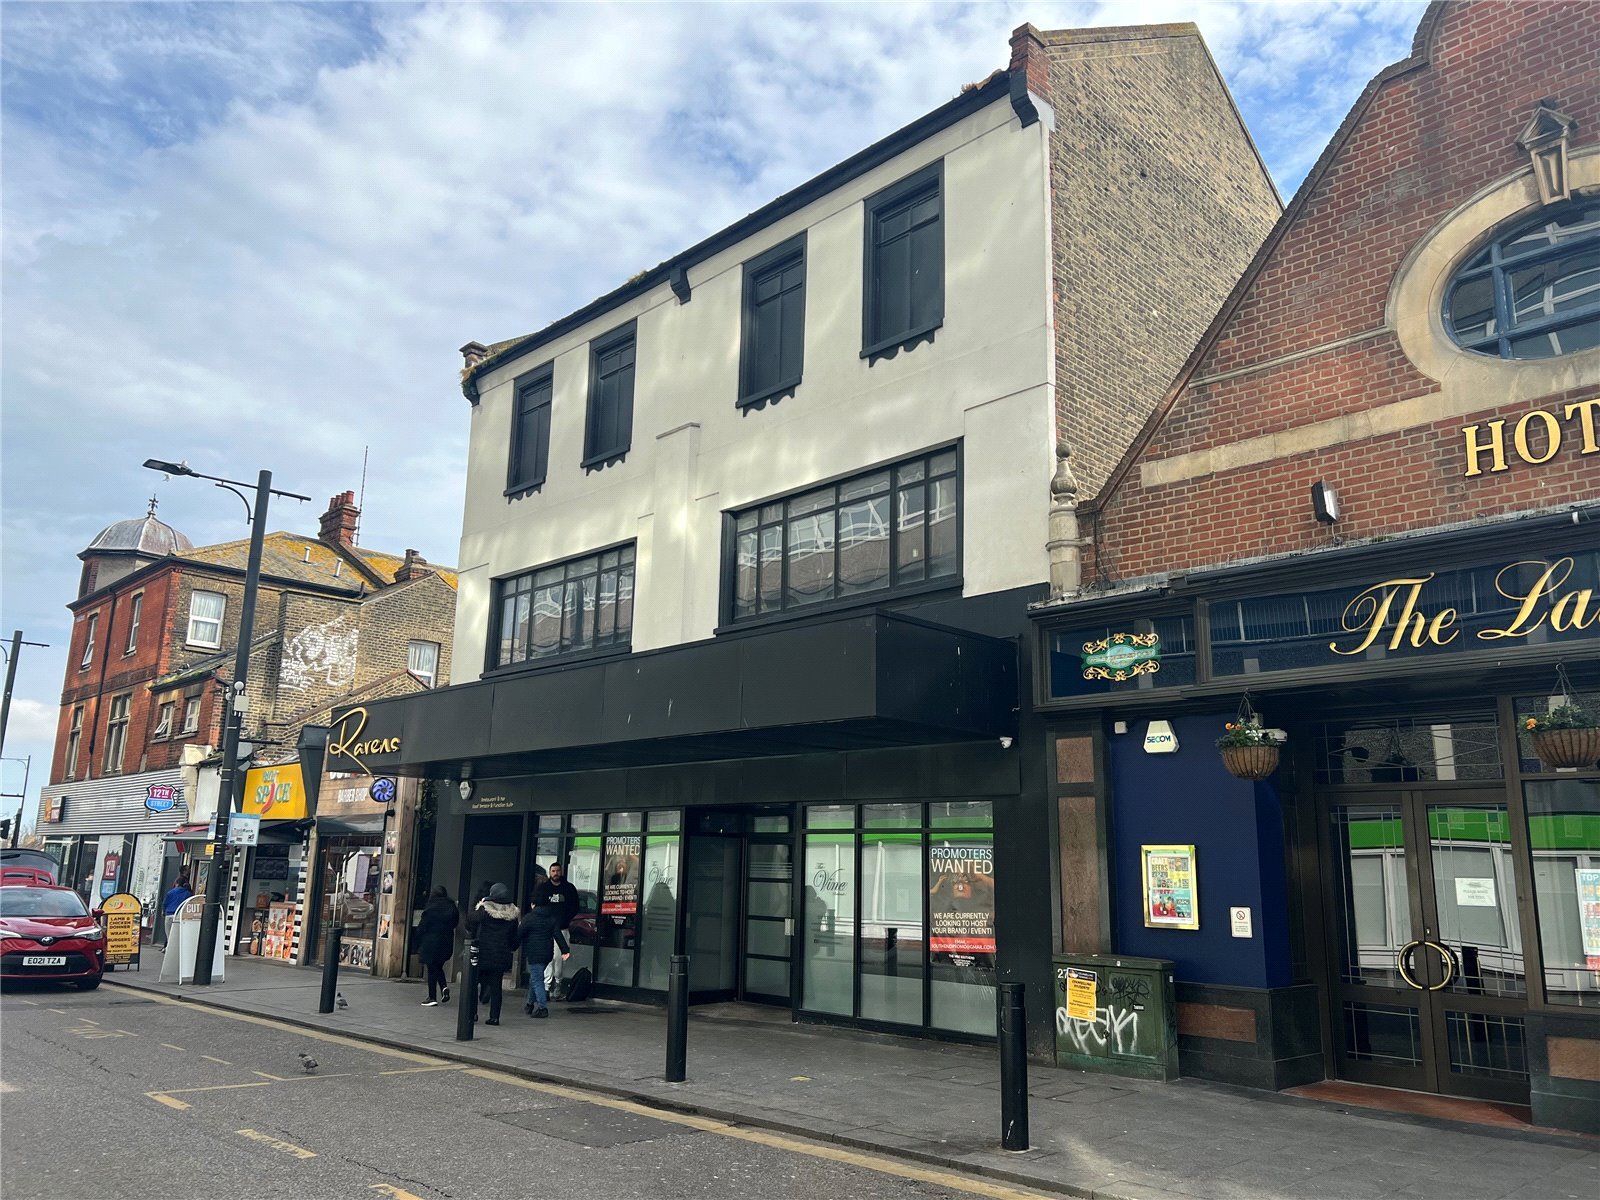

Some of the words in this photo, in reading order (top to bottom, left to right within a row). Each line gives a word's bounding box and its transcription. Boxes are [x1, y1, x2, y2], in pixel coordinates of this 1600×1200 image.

[1329, 572, 1460, 655] The
[1477, 557, 1600, 640] La
[329, 706, 401, 775] Ravens
[1146, 735, 1171, 743] SECOM
[153, 789, 170, 798] 12TH
[606, 836, 641, 845] PROMOTERS
[606, 844, 640, 856] WANTED
[931, 848, 992, 860] PROMOTERS
[931, 858, 993, 875] WANTED
[813, 868, 846, 891] Vine
[186, 903, 201, 913] CUT
